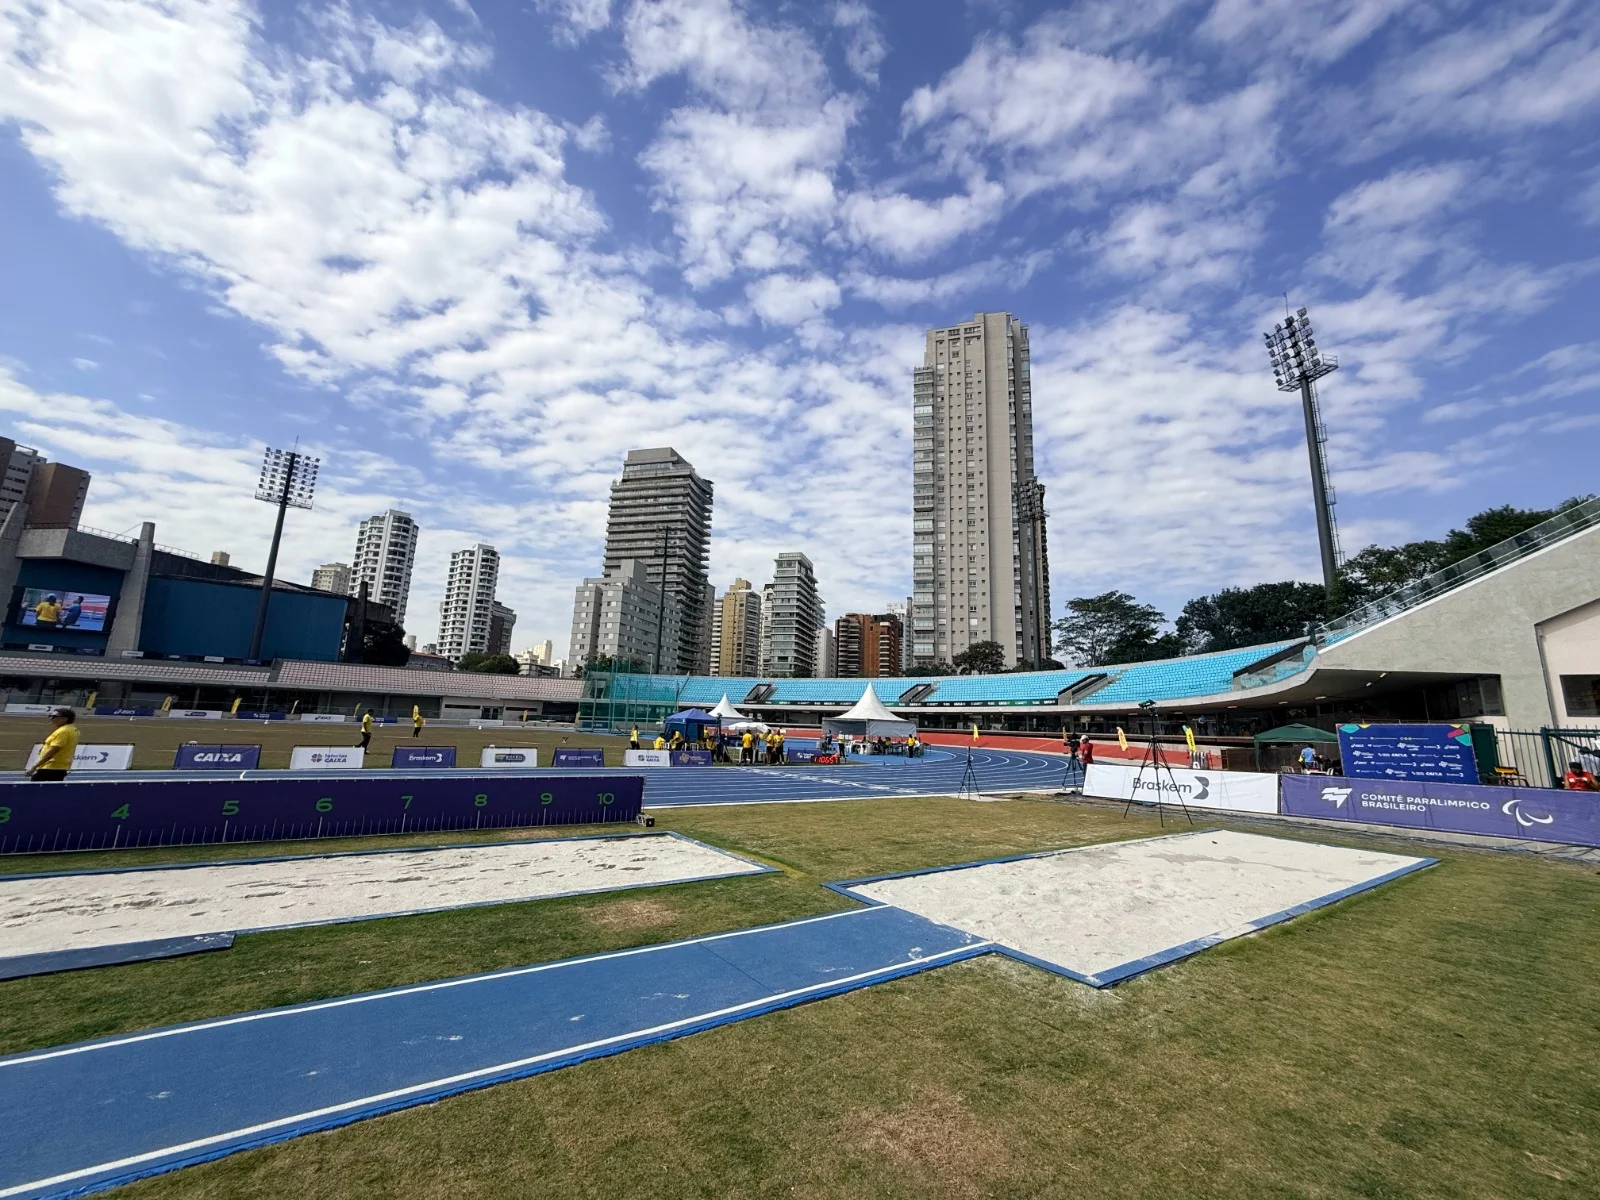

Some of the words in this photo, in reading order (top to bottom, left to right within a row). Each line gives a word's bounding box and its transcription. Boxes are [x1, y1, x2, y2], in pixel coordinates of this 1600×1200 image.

[193, 752, 242, 762] CAIXA
[1132, 777, 1192, 793] Braskem
[401, 795, 413, 809] 7
[475, 794, 488, 807] 8
[540, 793, 553, 805] 9
[597, 793, 614, 805] 10
[1361, 792, 1404, 803] COMITÊ
[111, 803, 130, 820] 4
[222, 800, 240, 816] 5
[315, 798, 333, 812] 6
[1361, 801, 1426, 812] BRASILEIRO
